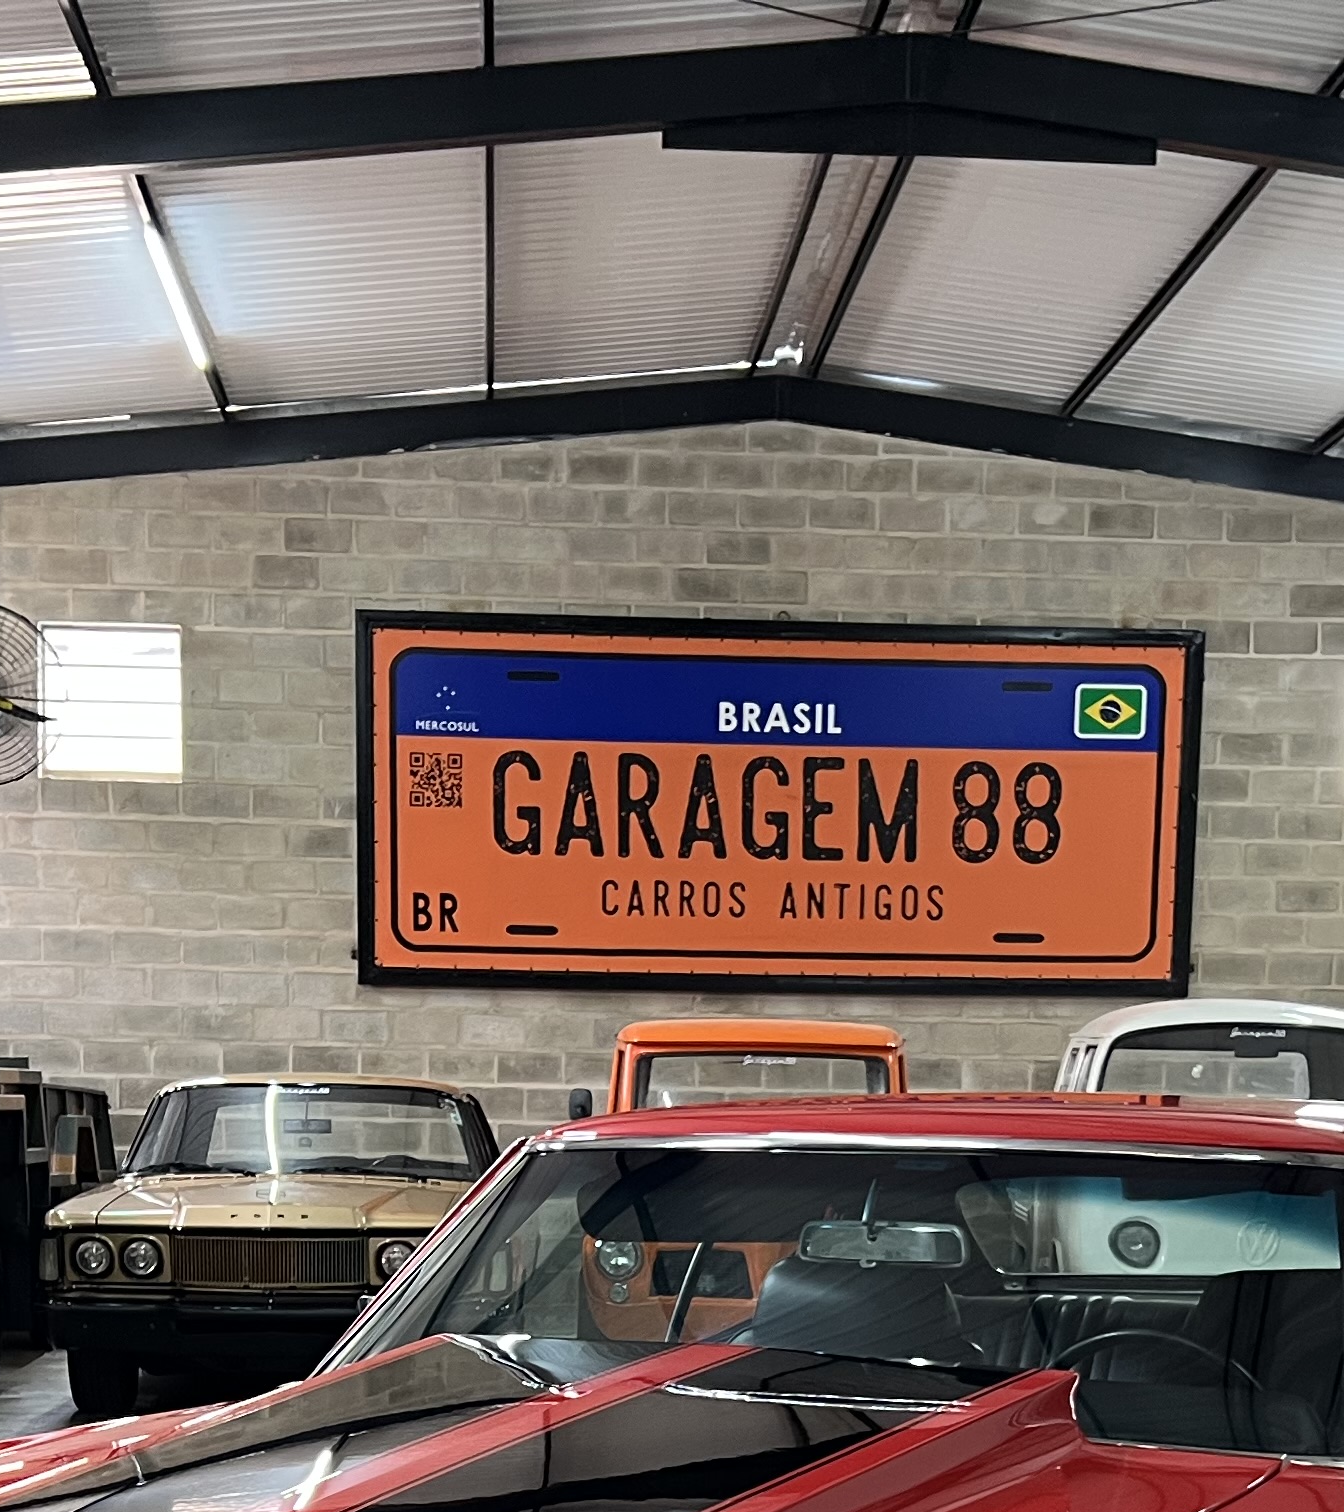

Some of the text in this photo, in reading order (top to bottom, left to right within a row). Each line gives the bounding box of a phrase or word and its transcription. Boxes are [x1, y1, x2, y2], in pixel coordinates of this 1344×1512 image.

[415, 719, 480, 733] MERCOSUL
[718, 700, 843, 736] BRASIL
[492, 750, 1063, 865] GARAGEM 88
[411, 892, 460, 935] BR
[600, 879, 945, 922] CARROS ANTIGOS
